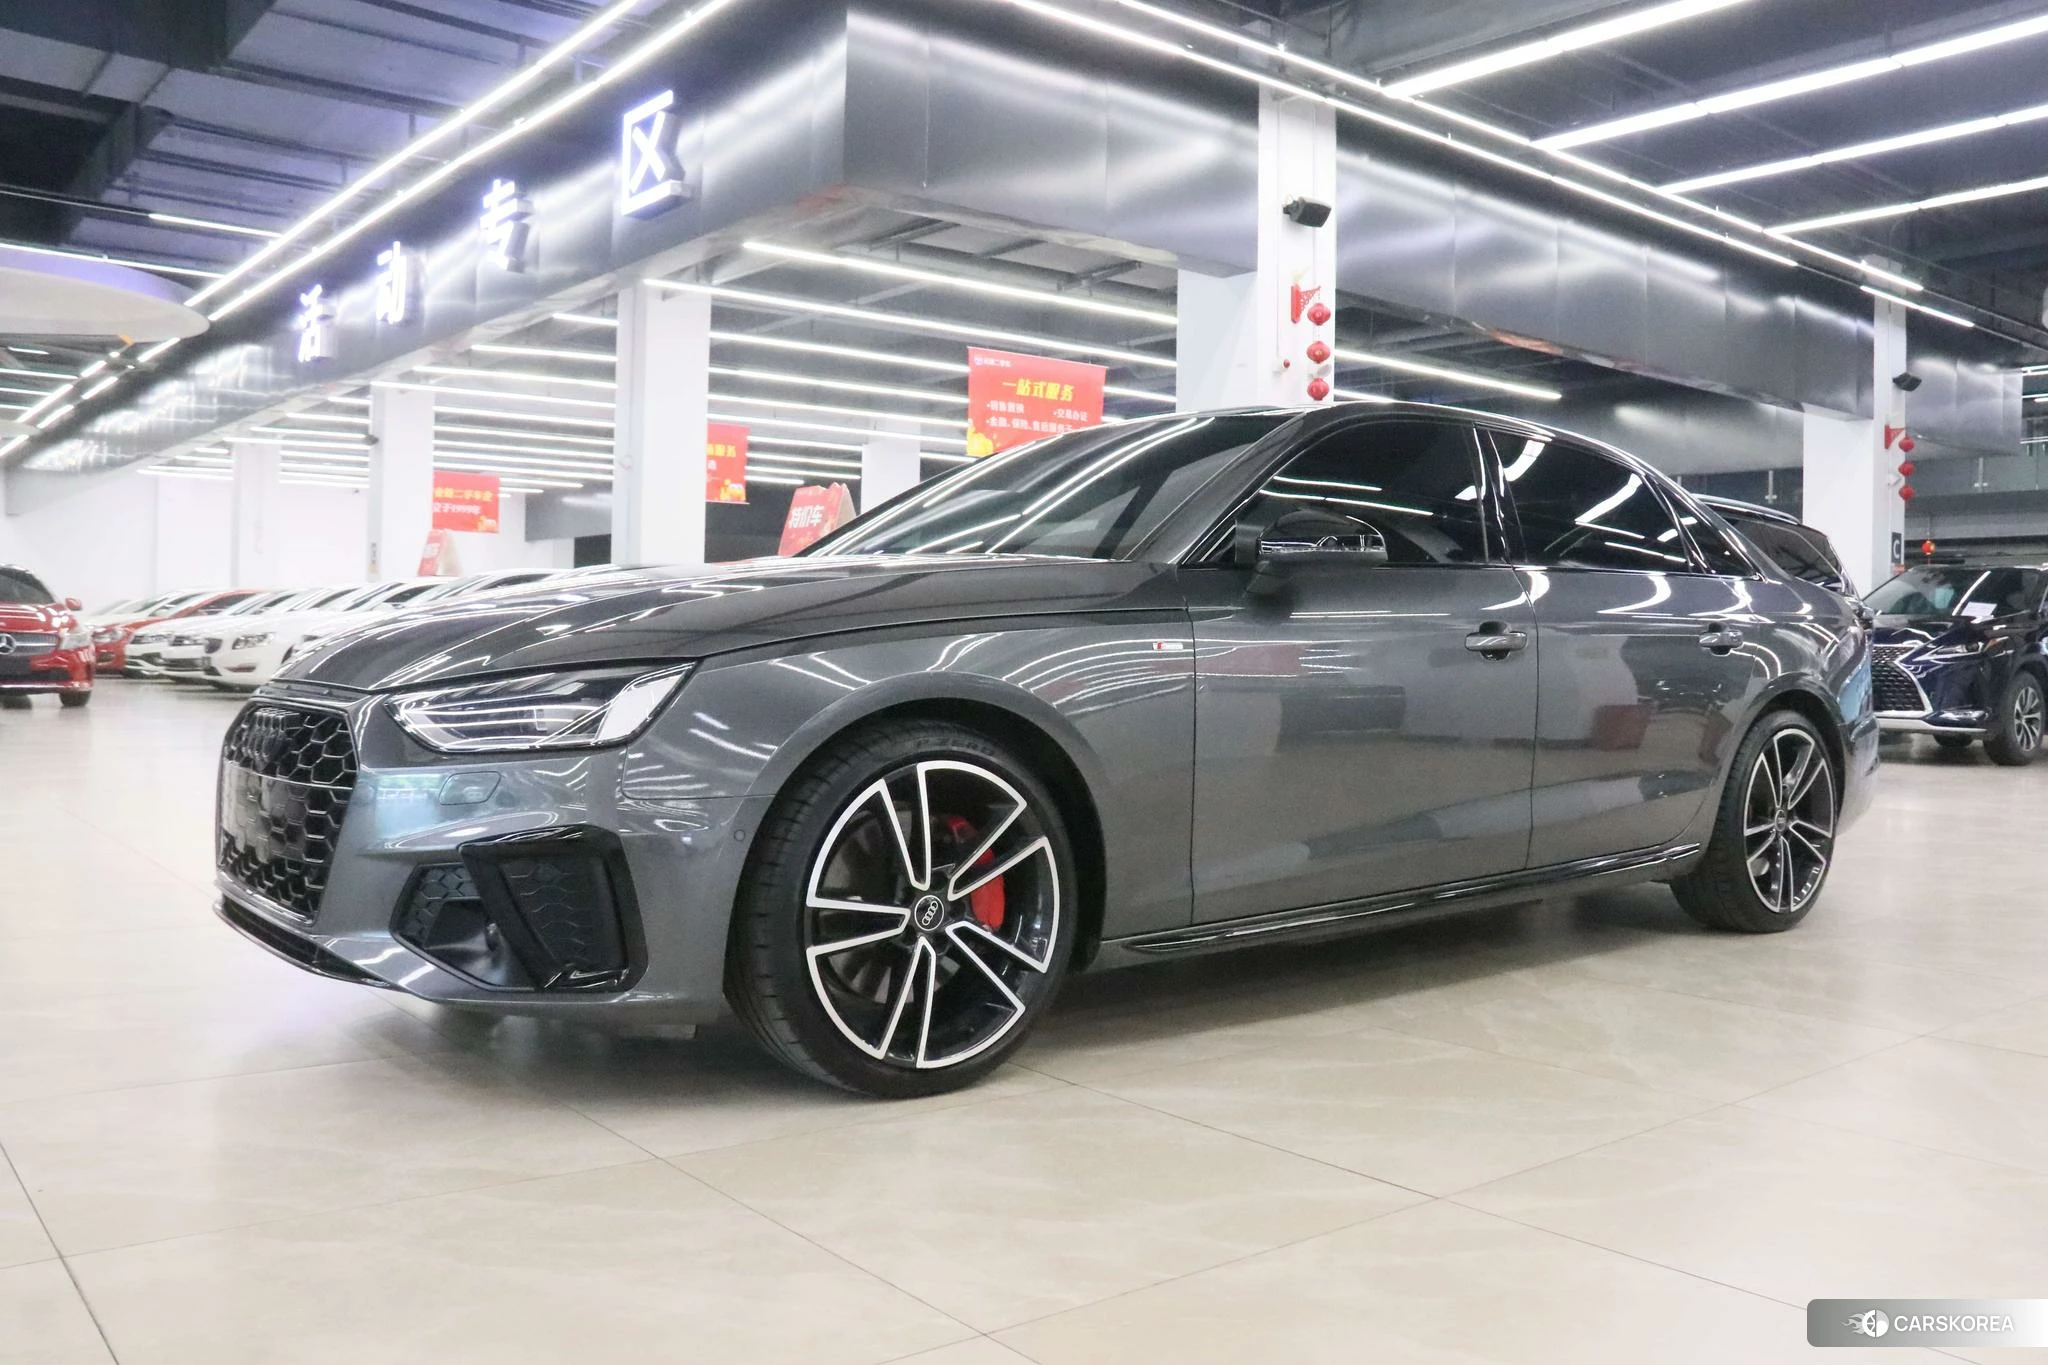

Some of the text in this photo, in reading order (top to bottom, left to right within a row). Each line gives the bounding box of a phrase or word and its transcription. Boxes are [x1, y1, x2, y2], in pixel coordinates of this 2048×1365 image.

[295, 89, 688, 363] 活动专区
[1003, 379, 1074, 402] 一站式服务
[788, 505, 825, 529] 特价车
[1893, 540, 1900, 559] C
